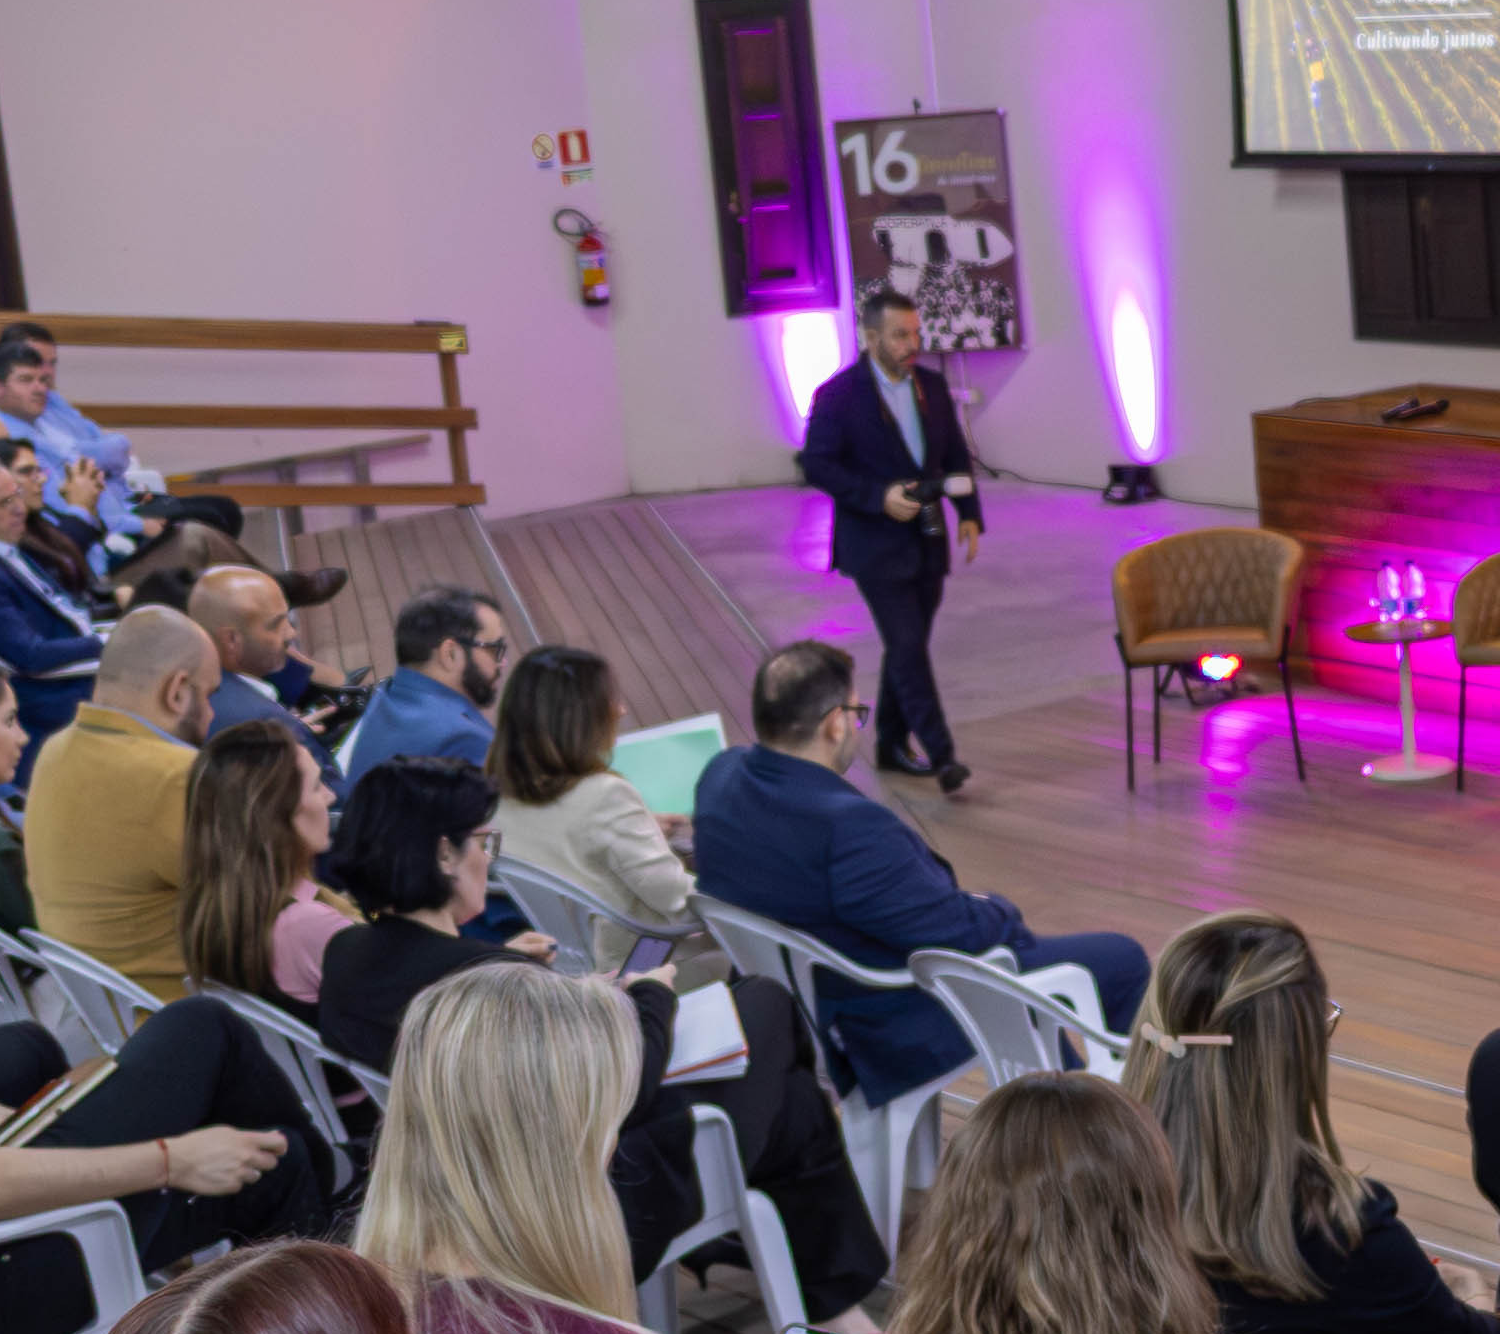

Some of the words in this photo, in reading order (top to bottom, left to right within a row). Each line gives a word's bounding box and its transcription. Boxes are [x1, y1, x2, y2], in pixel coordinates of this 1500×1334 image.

[1356, 29, 1439, 50] Cultivando
[1442, 29, 1495, 53] juntos
[841, 130, 920, 197] 16
